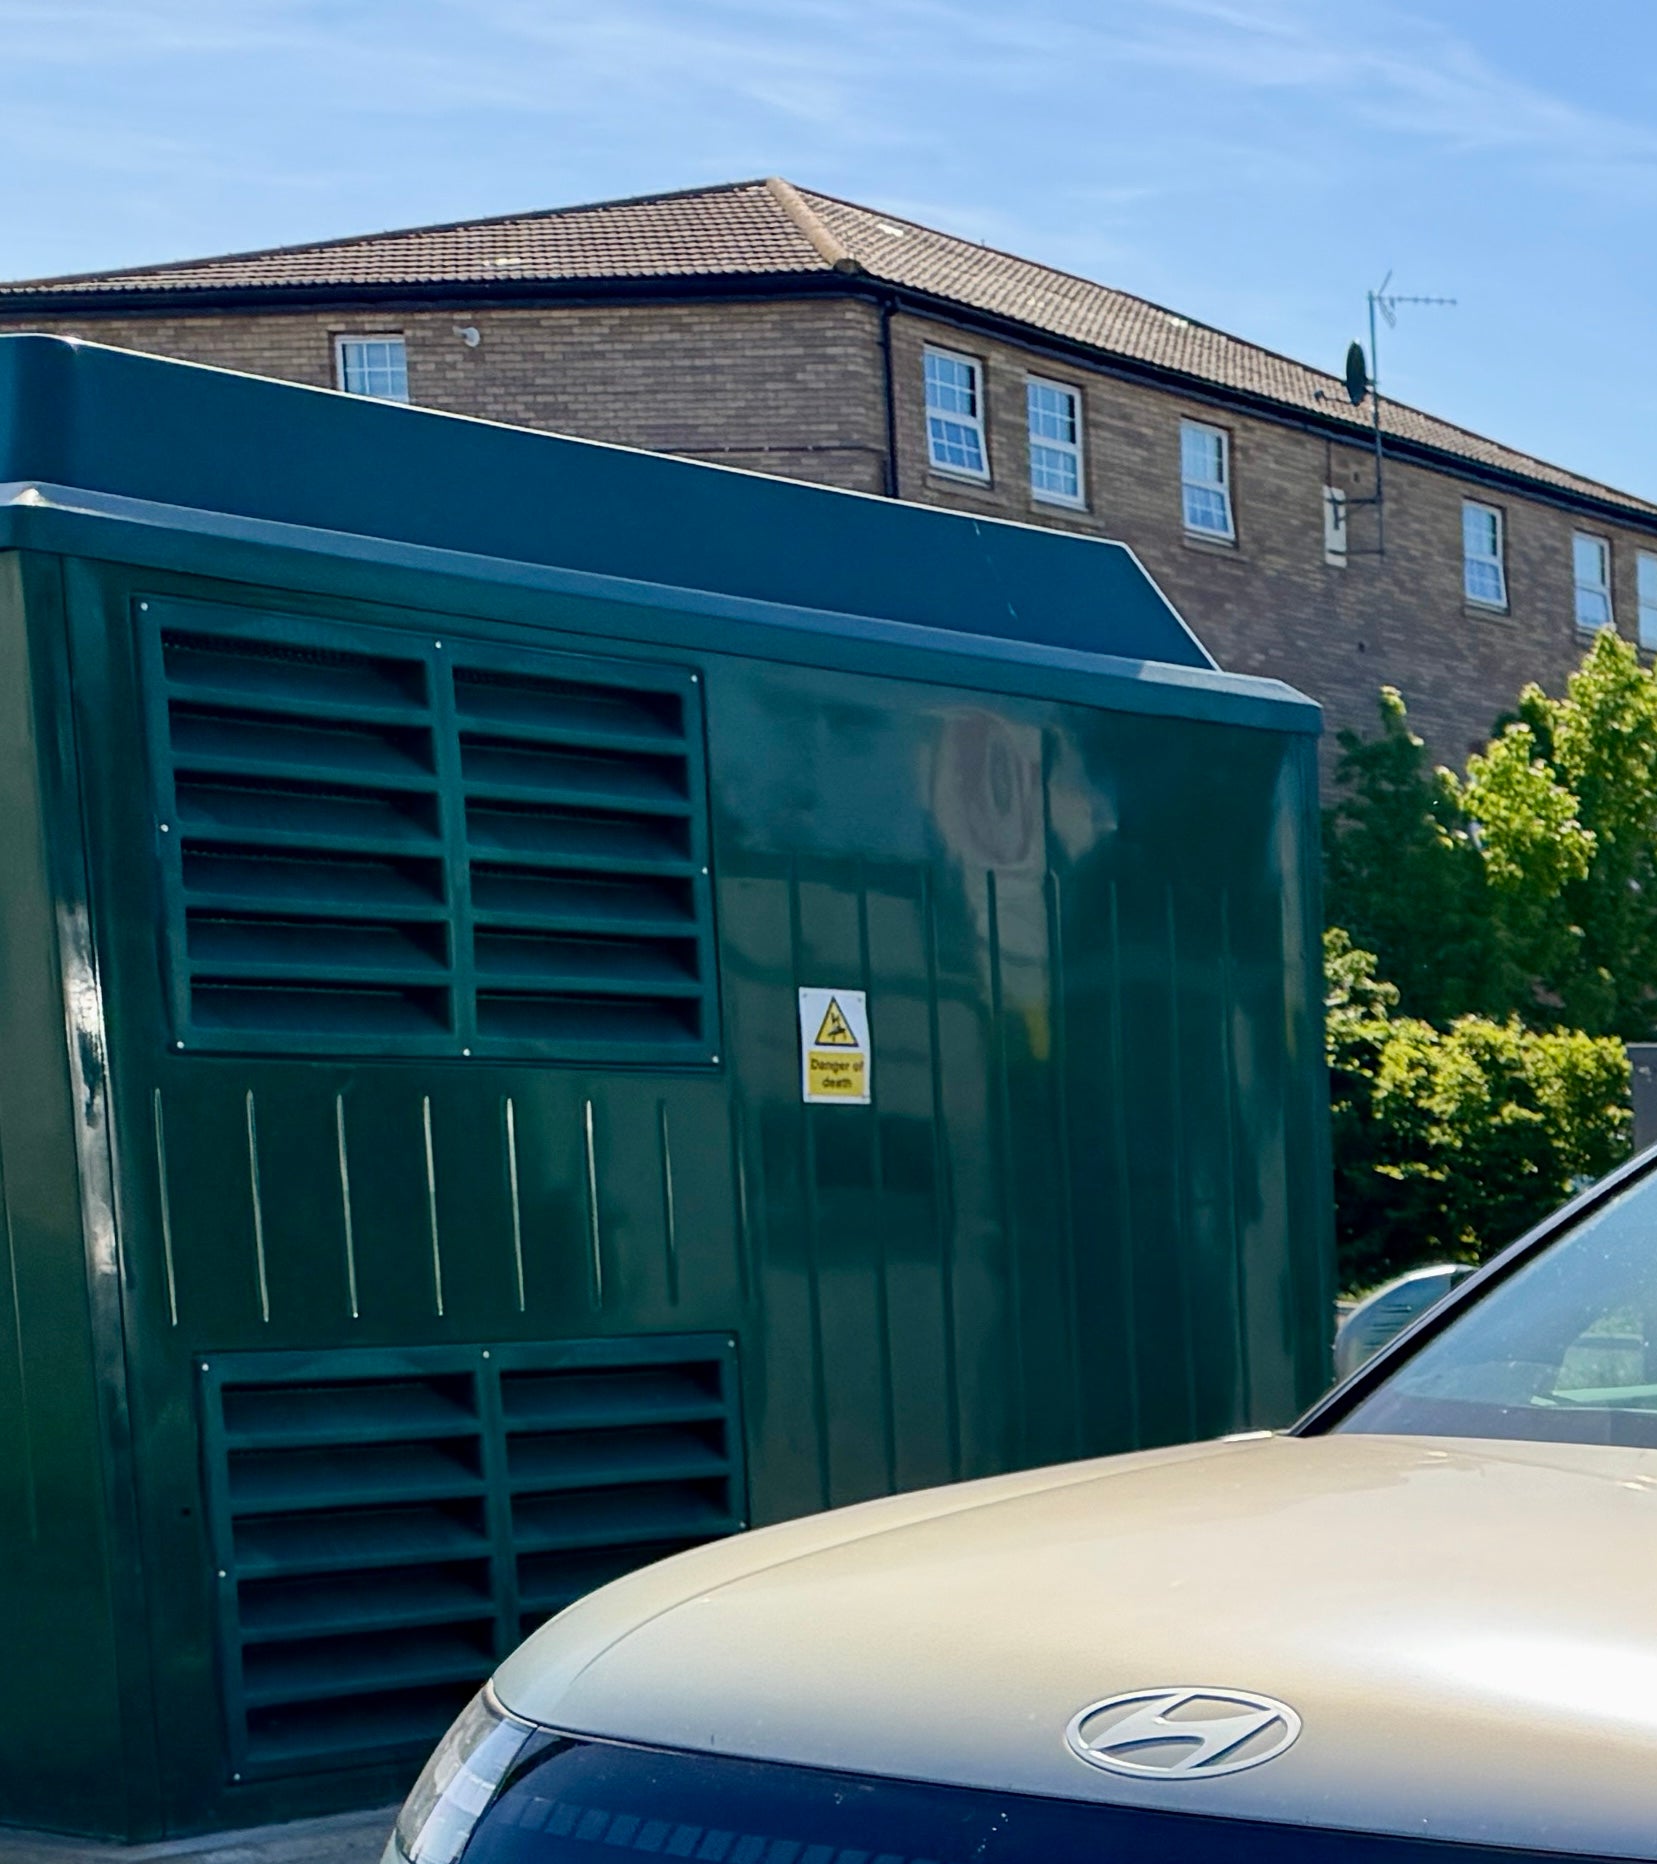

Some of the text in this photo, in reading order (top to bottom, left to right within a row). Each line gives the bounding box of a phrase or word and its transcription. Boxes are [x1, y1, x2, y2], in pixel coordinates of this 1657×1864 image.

[810, 1058, 864, 1075] Danger of
[822, 1077, 852, 1089] death
